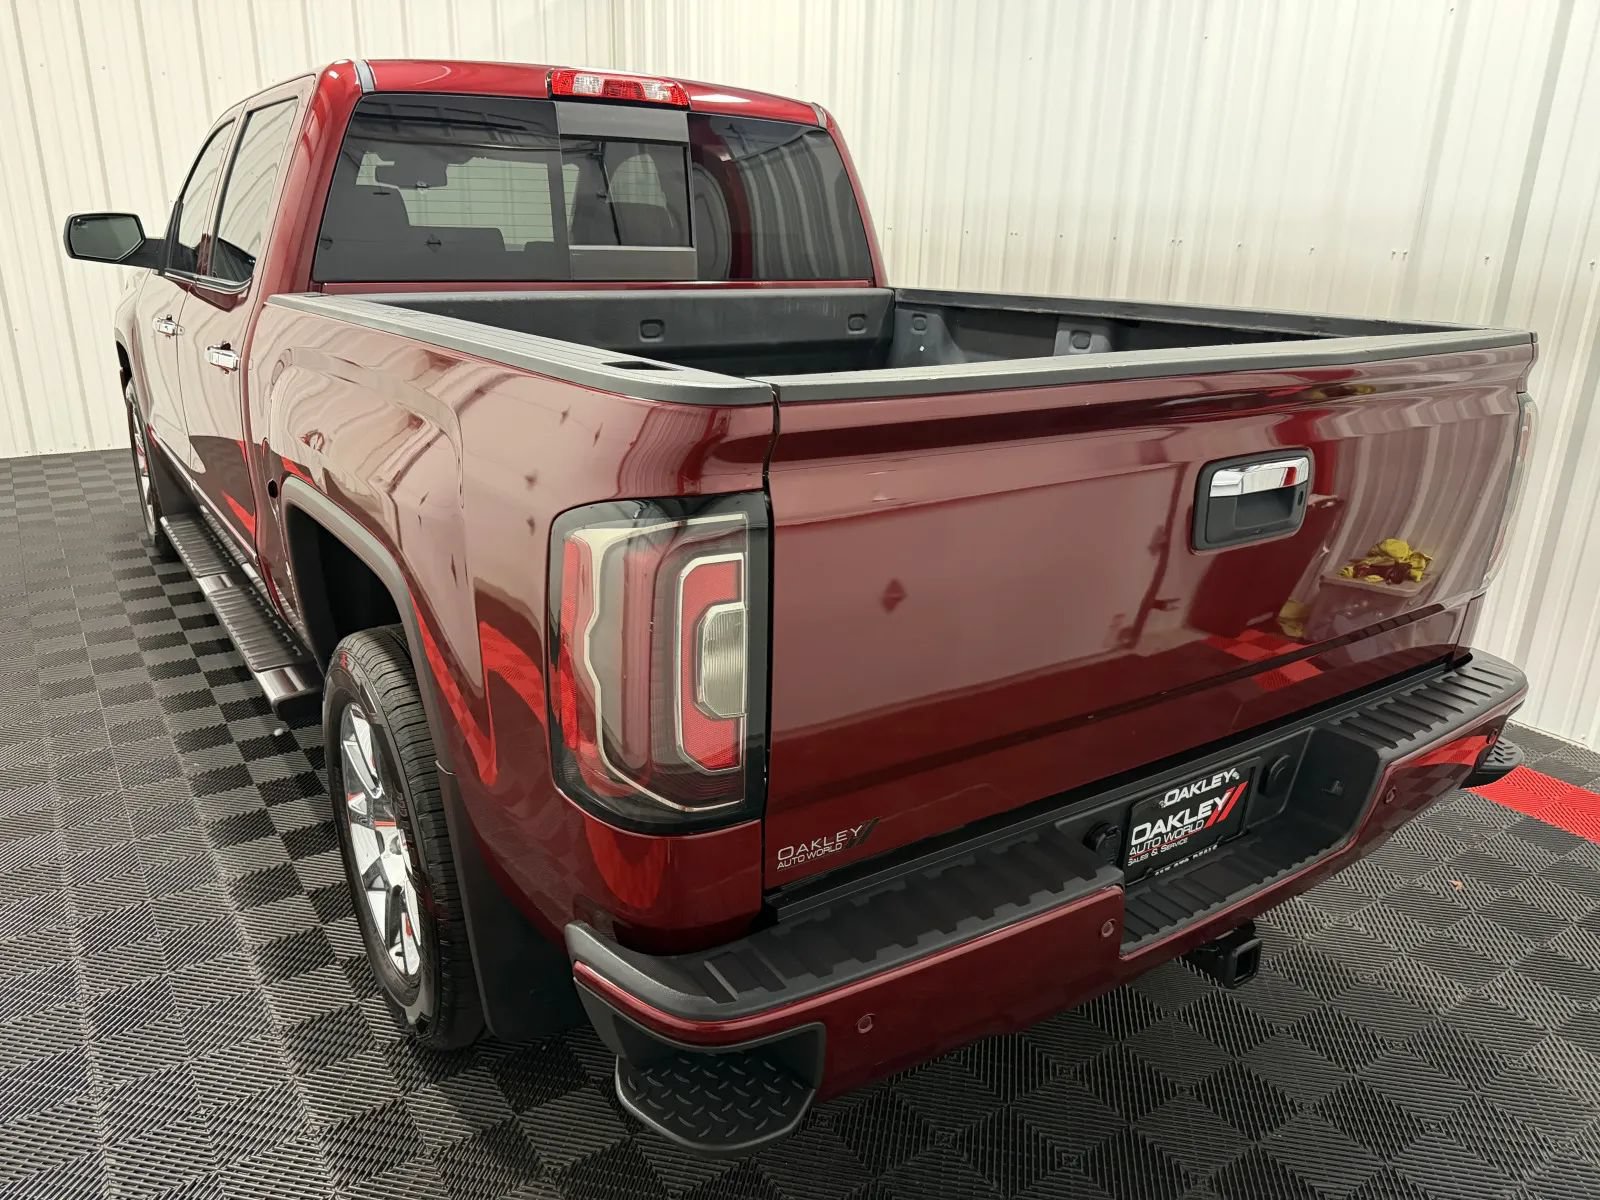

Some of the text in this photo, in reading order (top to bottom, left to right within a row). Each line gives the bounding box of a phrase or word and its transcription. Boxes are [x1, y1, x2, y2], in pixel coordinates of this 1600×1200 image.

[1164, 767, 1236, 808] OAKLEY
[1131, 790, 1235, 846] OAKLEY
[777, 825, 863, 861] OAKLEY
[1129, 819, 1205, 856] AUTO WORLD
[1151, 848, 1159, 857] &
[777, 842, 843, 870] AUTO WORLD
